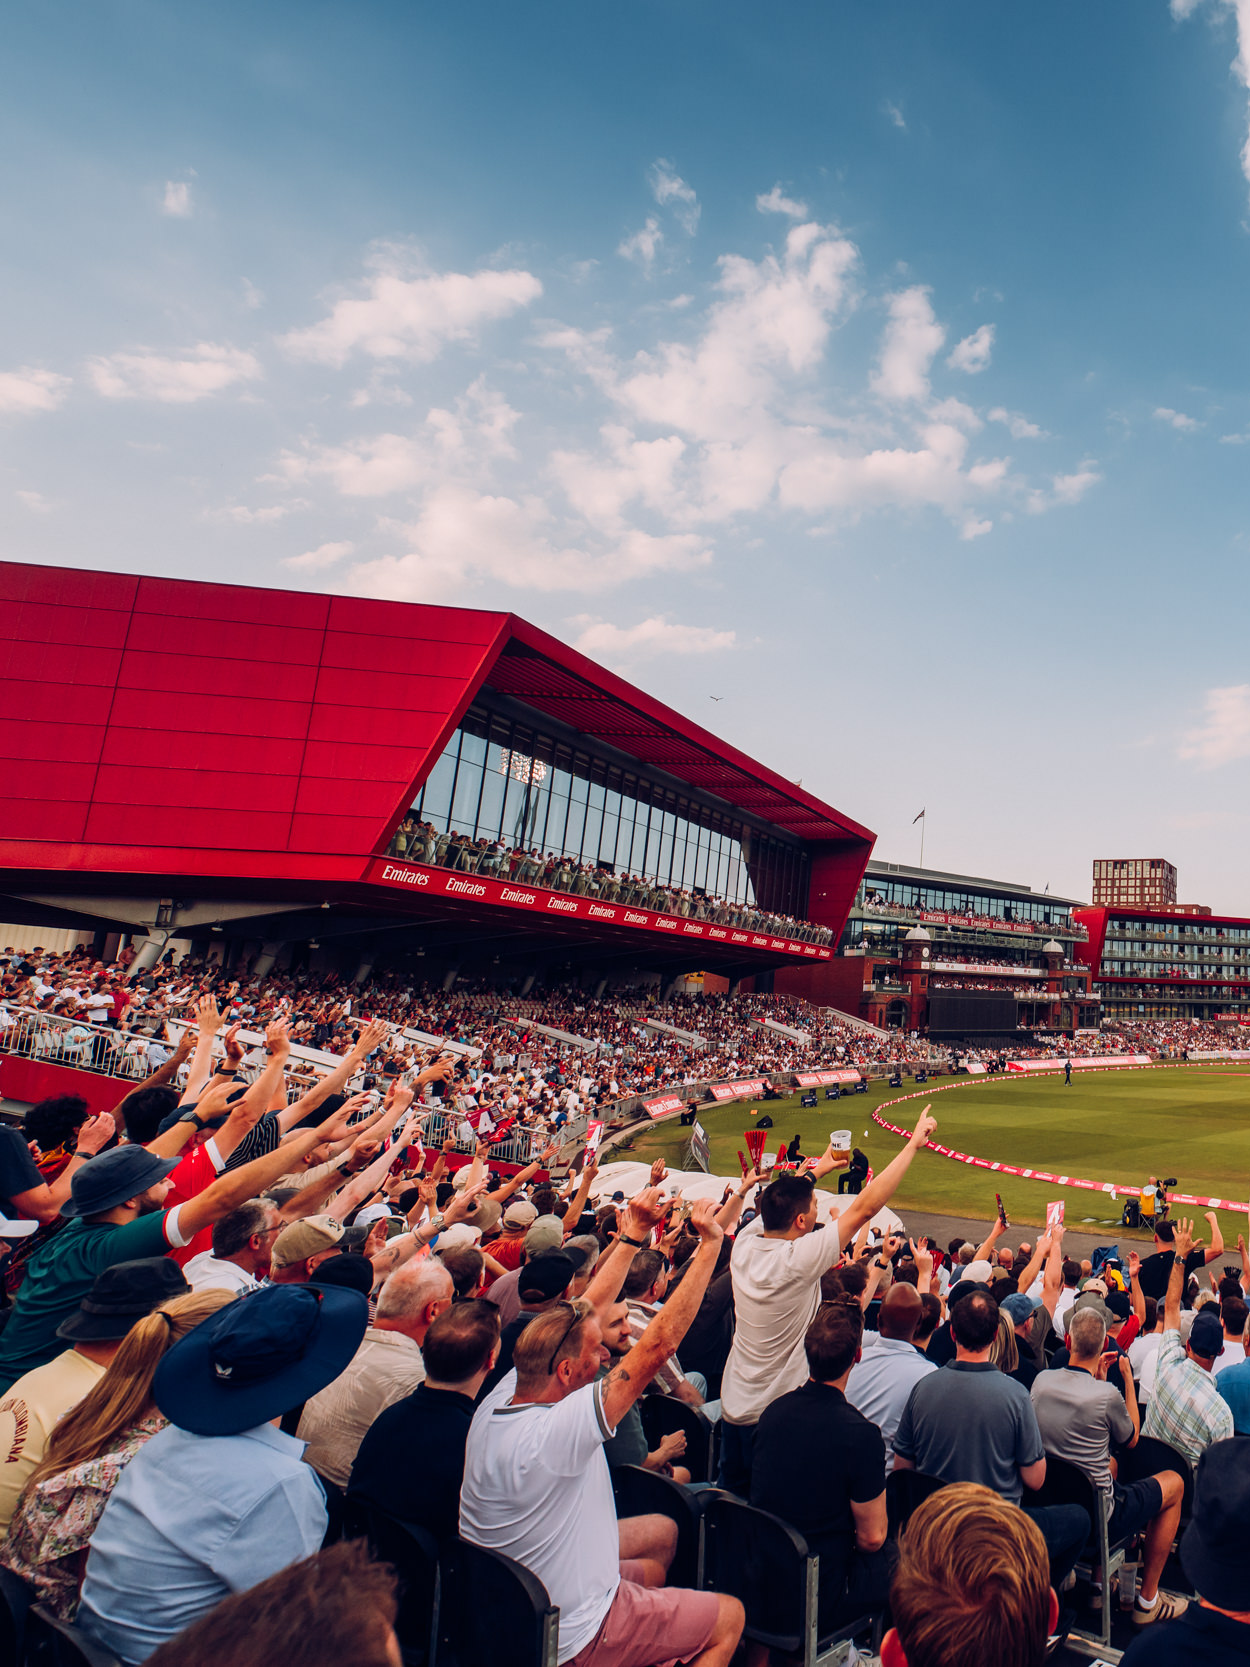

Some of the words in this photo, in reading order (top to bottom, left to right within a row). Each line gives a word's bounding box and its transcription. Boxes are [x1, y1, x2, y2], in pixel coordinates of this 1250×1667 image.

[382, 865, 430, 886] Emirates
[445, 878, 486, 896] Emirates
[500, 888, 536, 904] Emirates
[547, 897, 578, 912] Emirates
[588, 904, 616, 918] Emirates
[624, 911, 648, 925] Emirates
[655, 917, 677, 929] Emirates
[683, 922, 704, 934] Emirates
[709, 928, 727, 938] Emirates
[732, 932, 748, 942] Emirates
[752, 936, 767, 946] Emirates
[924, 914, 945, 922] Emirates
[948, 916, 968, 925] Emirates
[971, 919, 990, 928] Emirates
[993, 922, 1011, 930] Emirates
